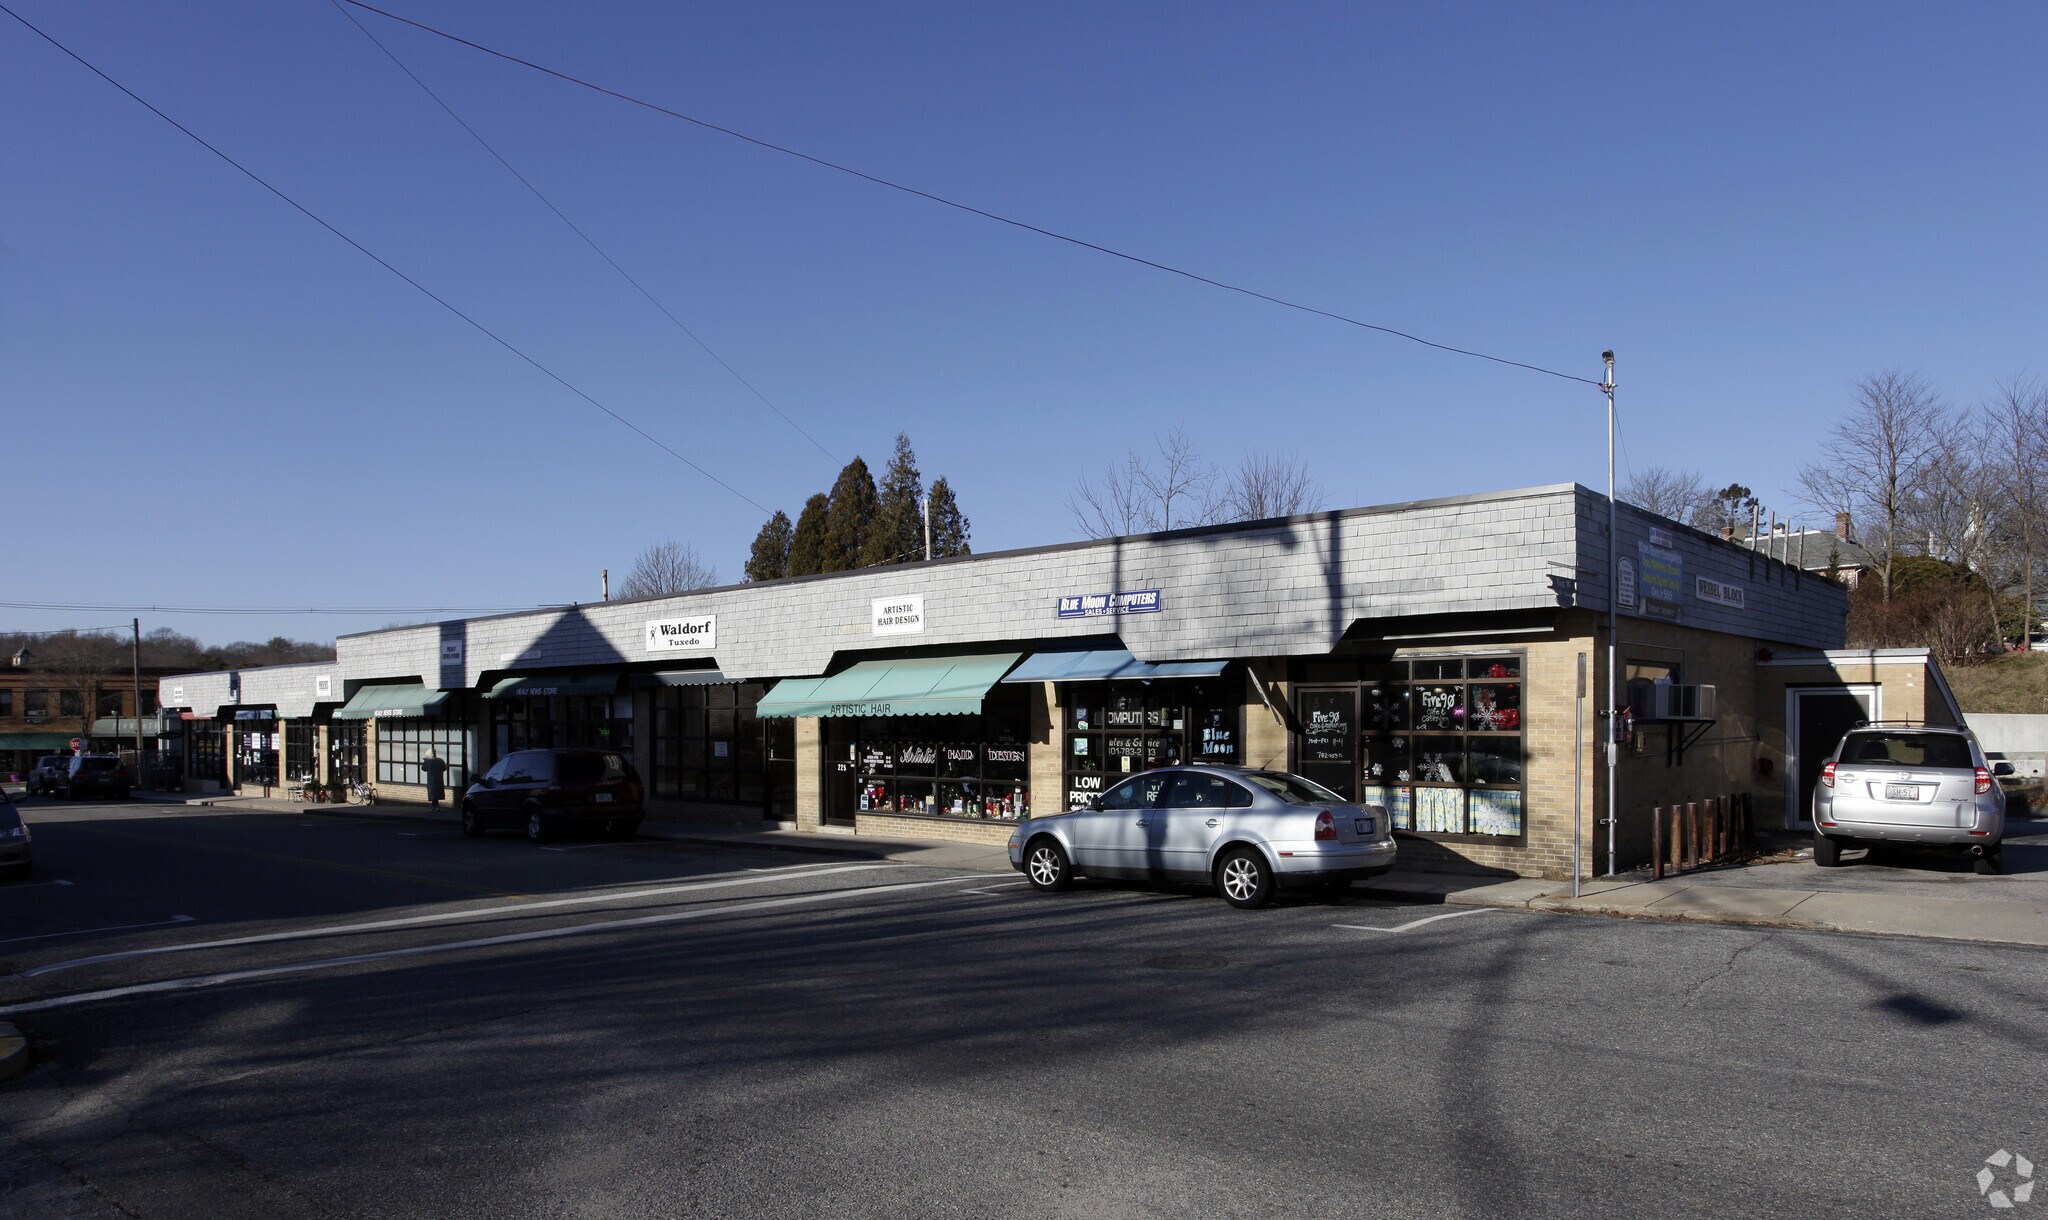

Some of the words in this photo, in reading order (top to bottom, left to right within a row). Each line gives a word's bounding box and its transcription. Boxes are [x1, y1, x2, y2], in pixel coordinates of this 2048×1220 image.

[1698, 579, 1721, 598] WEIBEL
[1723, 586, 1743, 603] BLOCK
[1060, 598, 1080, 611] BLUE
[1081, 596, 1107, 610] MOON
[1108, 592, 1157, 607] COMPUTERS
[883, 604, 914, 615] ARTISTIC
[877, 617, 894, 626] HAIR
[895, 614, 920, 625] DESIGN
[660, 621, 711, 636] Waldorf
[668, 638, 700, 647] Tuxedo
[830, 704, 866, 714] ARTISTIC
[870, 703, 891, 713] HAIR
[1202, 727, 1230, 741] Blue
[1108, 737, 1124, 747] ales
[1202, 741, 1235, 755] Moon
[947, 749, 975, 761] HAIR
[987, 750, 1025, 762] DESIGN
[837, 763, 847, 772] 225
[1075, 776, 1102, 789] LOW
